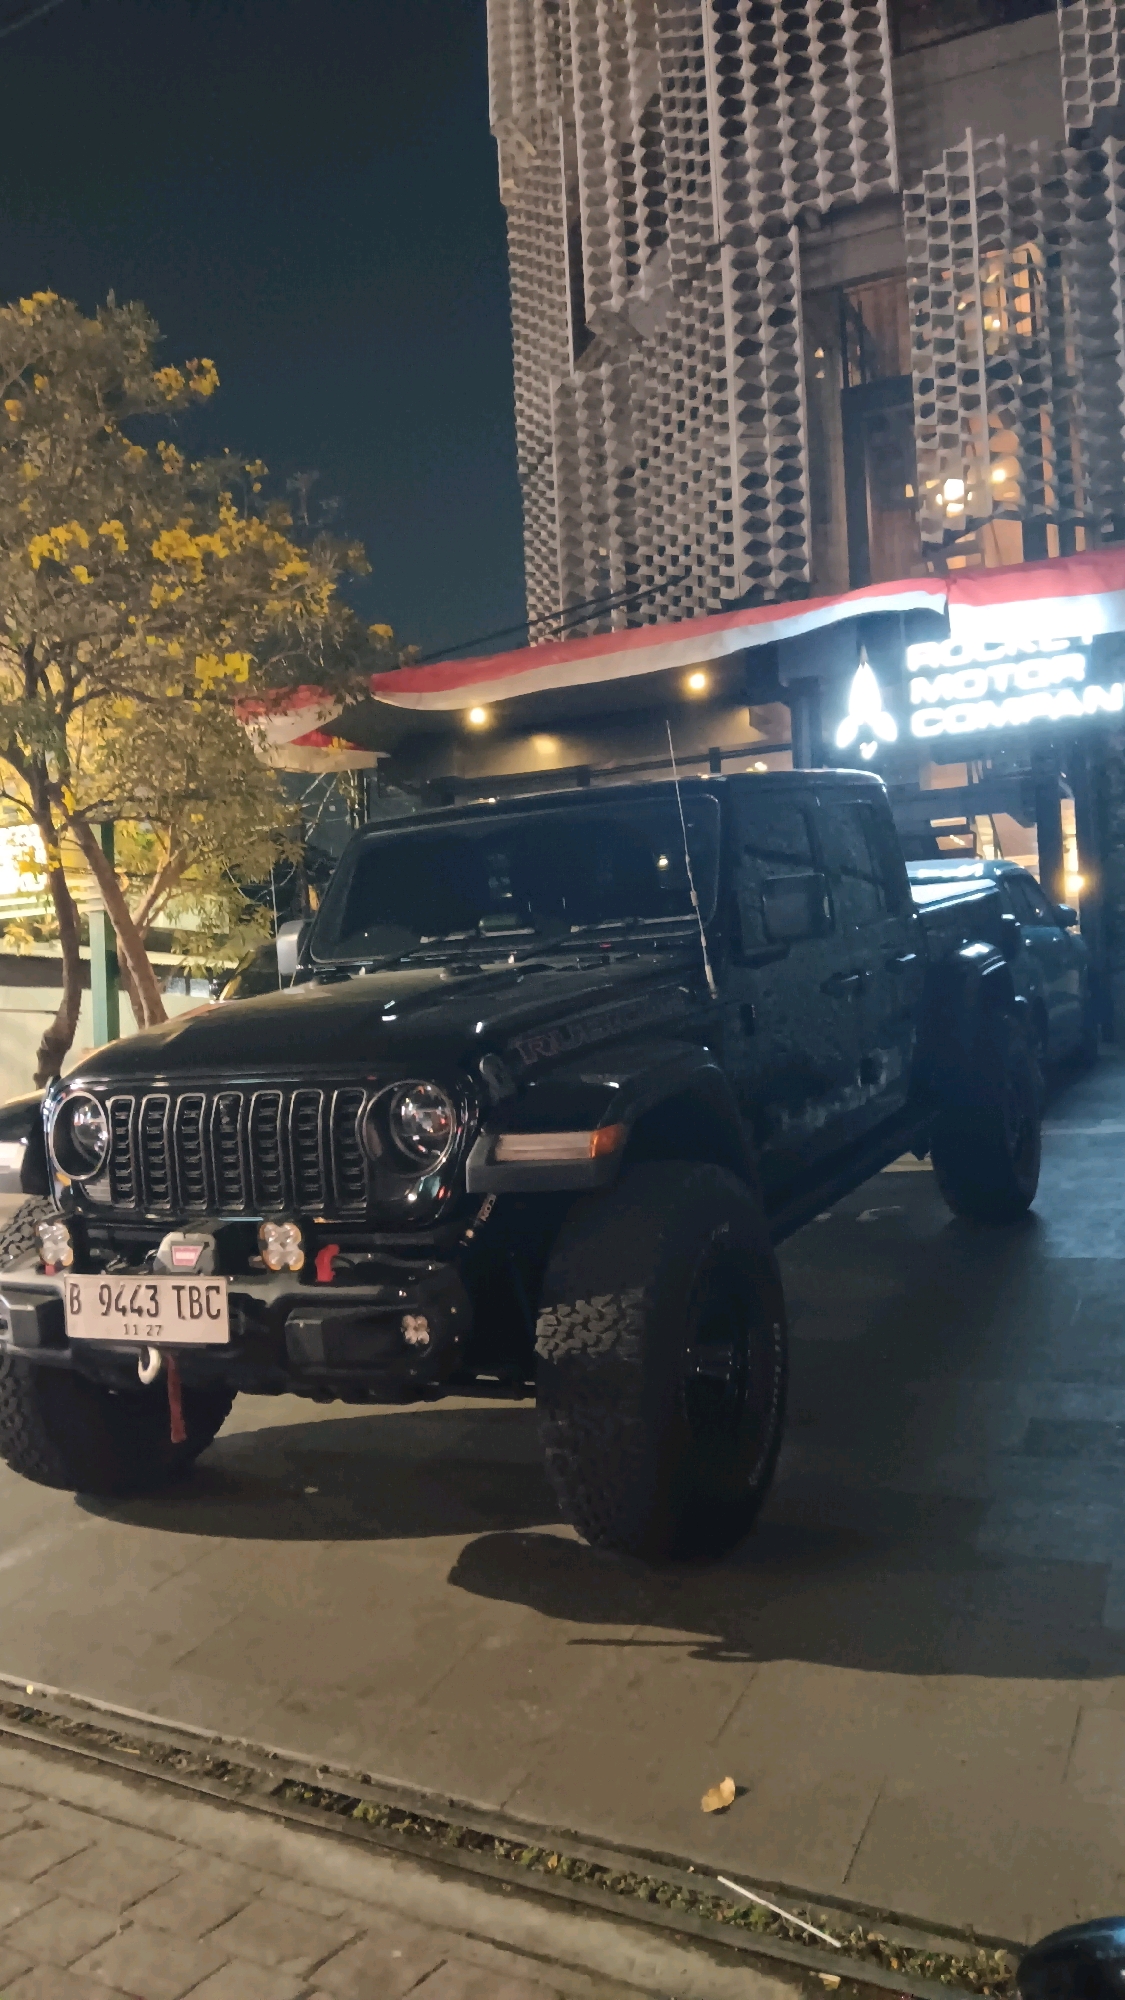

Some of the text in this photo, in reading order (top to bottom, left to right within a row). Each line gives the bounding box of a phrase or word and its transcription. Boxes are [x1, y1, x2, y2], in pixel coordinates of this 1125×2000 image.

[910, 653, 1086, 704] MOTOR
[911, 682, 1125, 738] COMPAN
[69, 1282, 221, 1320] B 9443 TBC
